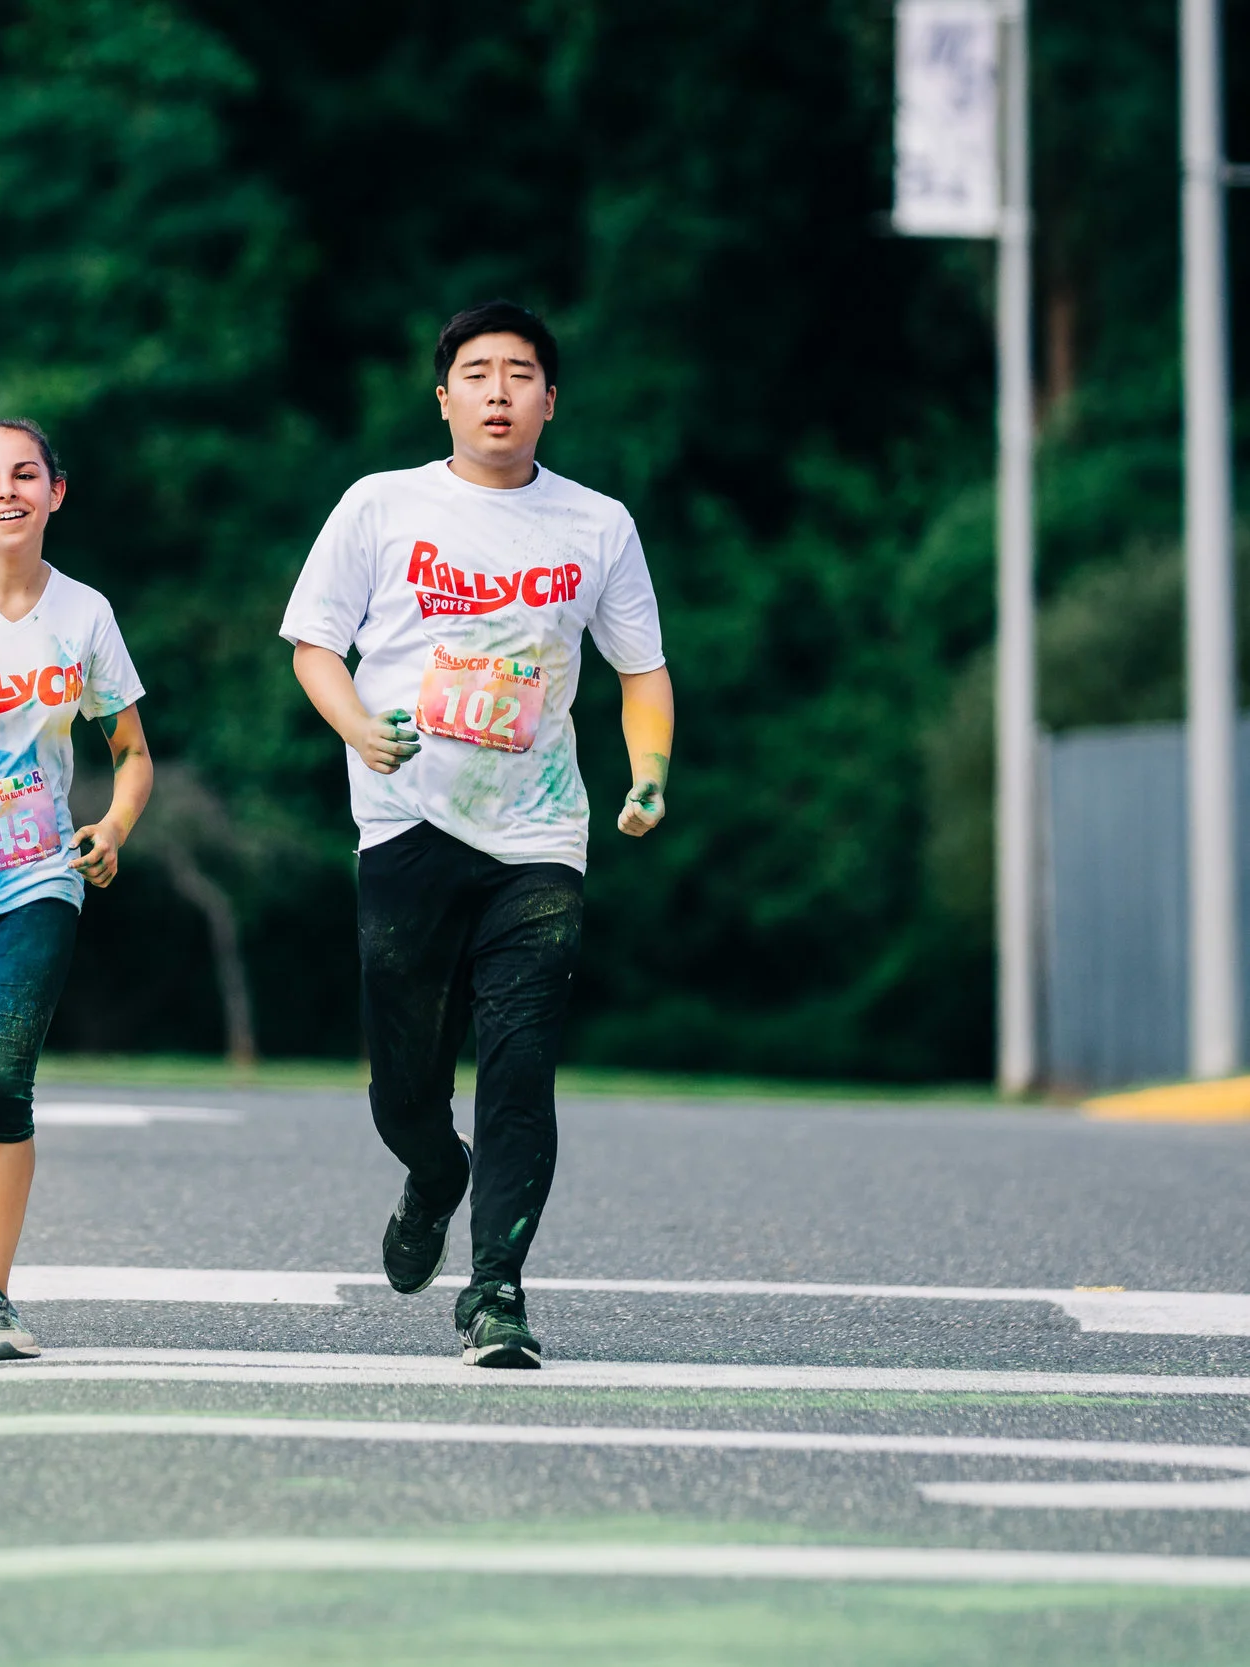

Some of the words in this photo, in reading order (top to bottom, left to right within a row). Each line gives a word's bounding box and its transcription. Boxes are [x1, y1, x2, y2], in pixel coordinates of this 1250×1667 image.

[406, 540, 582, 608] RALLYCAP
[423, 593, 472, 613] Sports
[442, 685, 521, 738] 102
